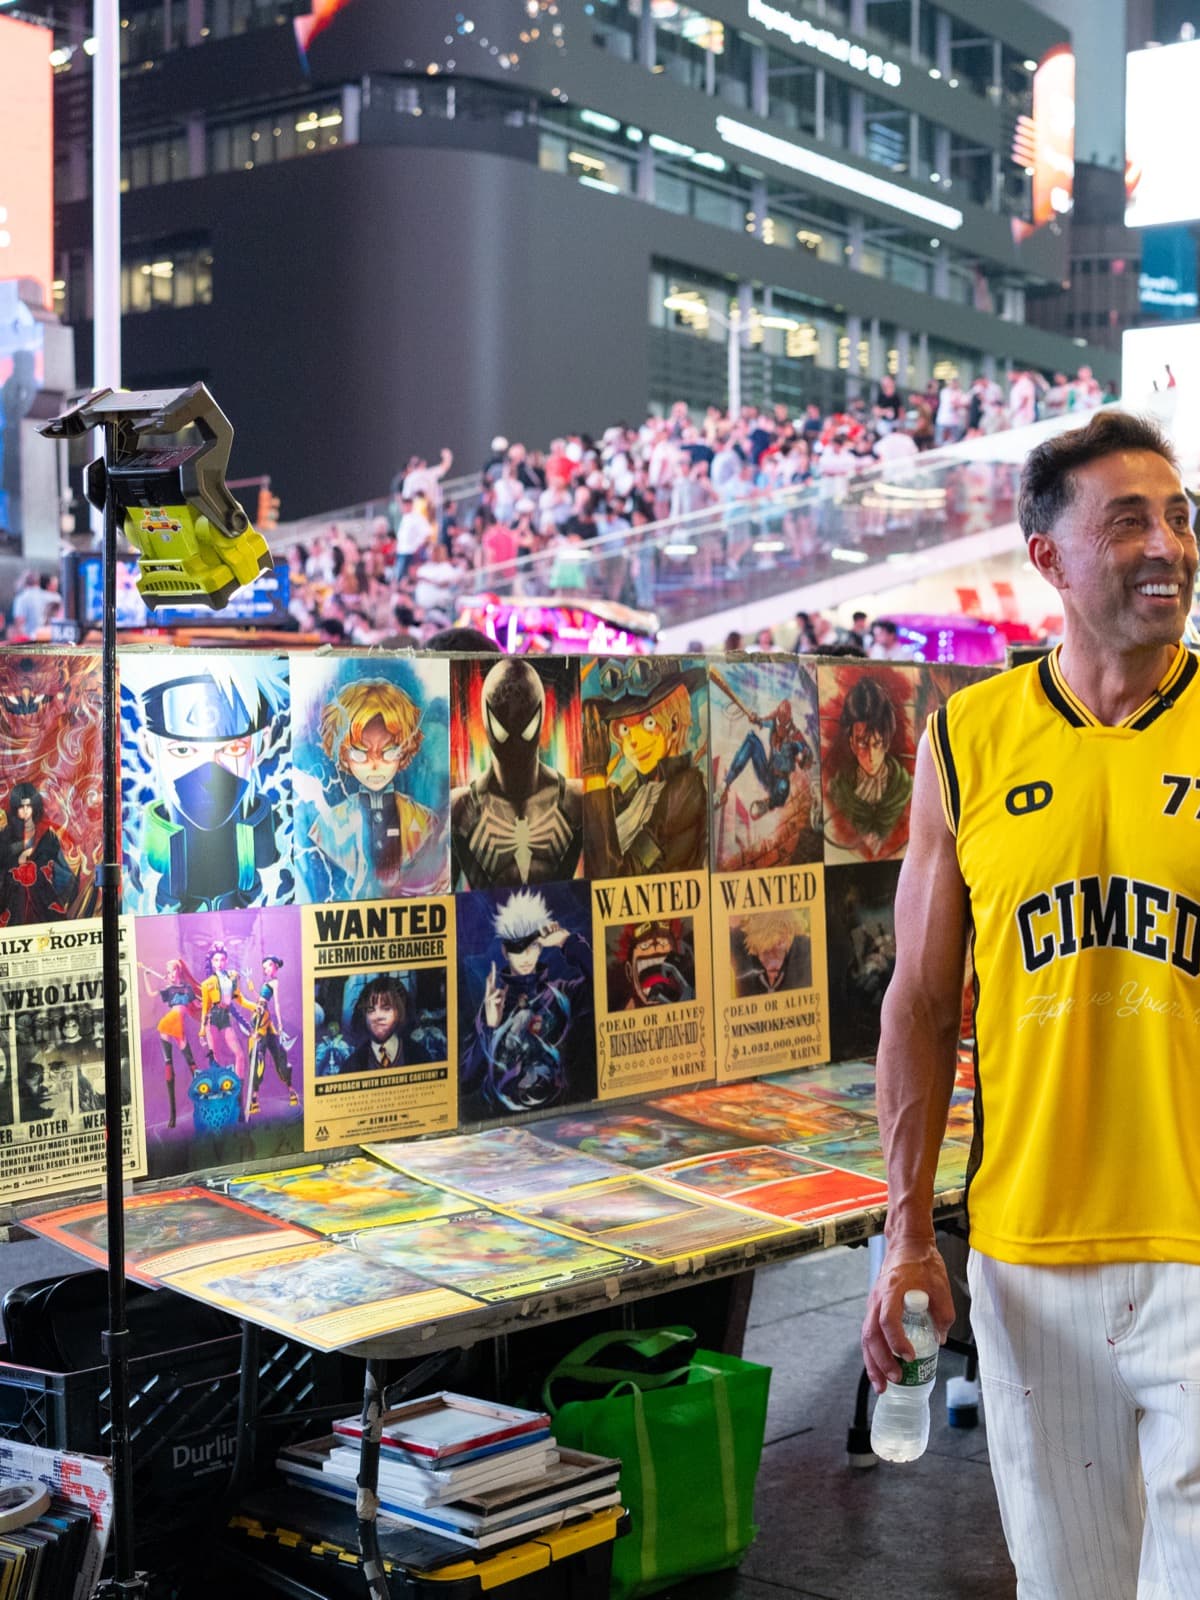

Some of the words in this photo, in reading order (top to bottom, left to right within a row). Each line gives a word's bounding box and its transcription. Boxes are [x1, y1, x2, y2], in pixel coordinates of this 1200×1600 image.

[594, 878, 702, 920] WANTED
[720, 871, 817, 911] WANTED
[315, 904, 447, 941] WANTED
[0, 938, 33, 956] ILY
[37, 928, 126, 952] PROPHT
[318, 944, 386, 965] HERMIONE
[388, 940, 444, 960] GRANGER
[2, 985, 59, 1011] WHO
[730, 1003, 758, 1017] DEAD
[764, 999, 778, 1012] OR
[785, 994, 815, 1009] ALIVE
[606, 1016, 635, 1033] DEAD
[643, 1014, 658, 1026] OR
[666, 1006, 699, 1023] ALIVE
[790, 1044, 822, 1060] MARINE
[671, 1061, 706, 1077] MARINE
[325, 1080, 360, 1093] APPROACH
[362, 1078, 379, 1088] WITH
[380, 1074, 408, 1086] EXTREME
[29, 1120, 68, 1139] POTTER
[6, 1145, 37, 1158] MINISTRY
[39, 1143, 47, 1153] OF
[48, 1141, 69, 1151] MAGIC
[33, 1149, 70, 1162] CONCERNING
[71, 1145, 88, 1156] THEIR
[0, 1166, 26, 1178] REPORT
[28, 1163, 45, 1172] WILL
[46, 1158, 70, 1170] RESULT
[72, 1156, 80, 1165] IN
